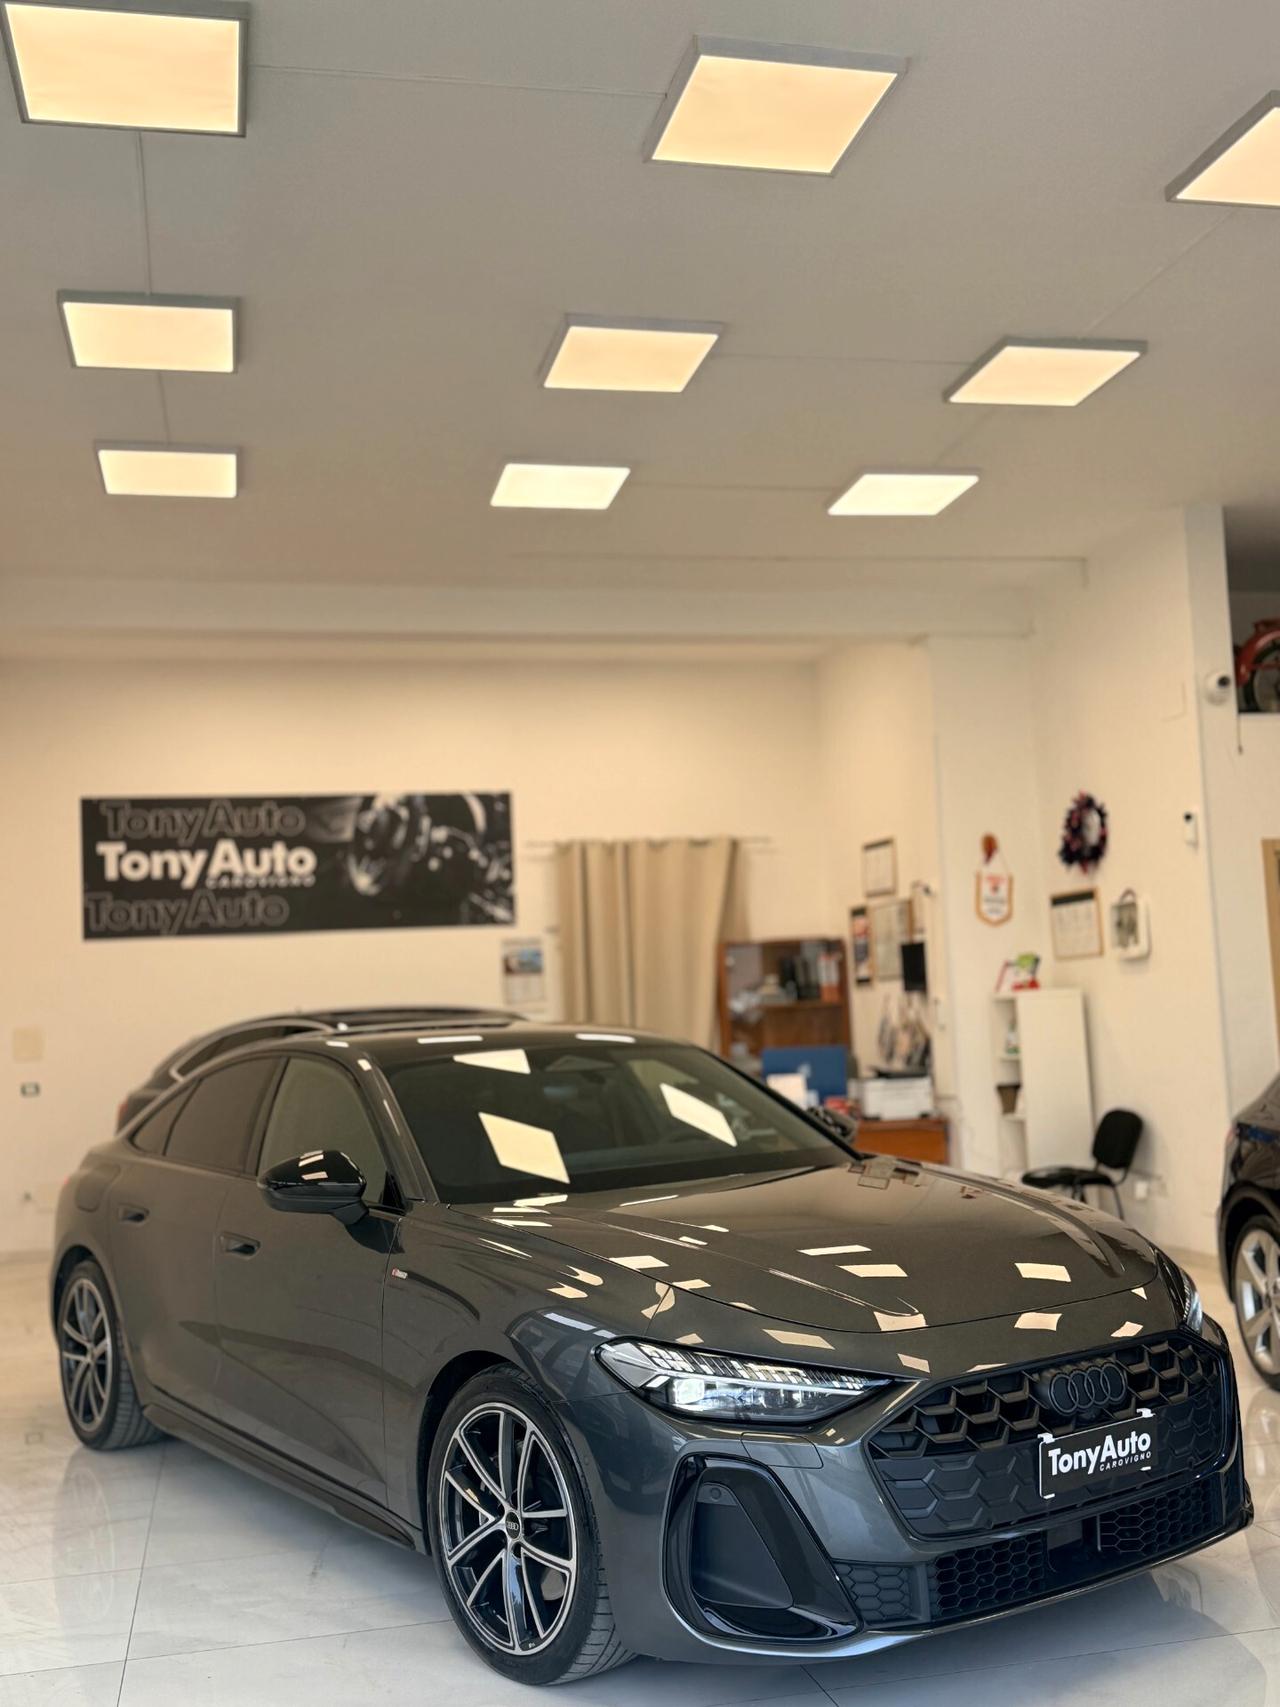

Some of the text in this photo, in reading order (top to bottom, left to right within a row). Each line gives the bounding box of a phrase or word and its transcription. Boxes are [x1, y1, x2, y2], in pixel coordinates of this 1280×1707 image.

[96, 838, 318, 889] TonyAuto
[1048, 1431, 1151, 1476] TonyAuto
[1099, 1450, 1152, 1472] CAROVIGNO
